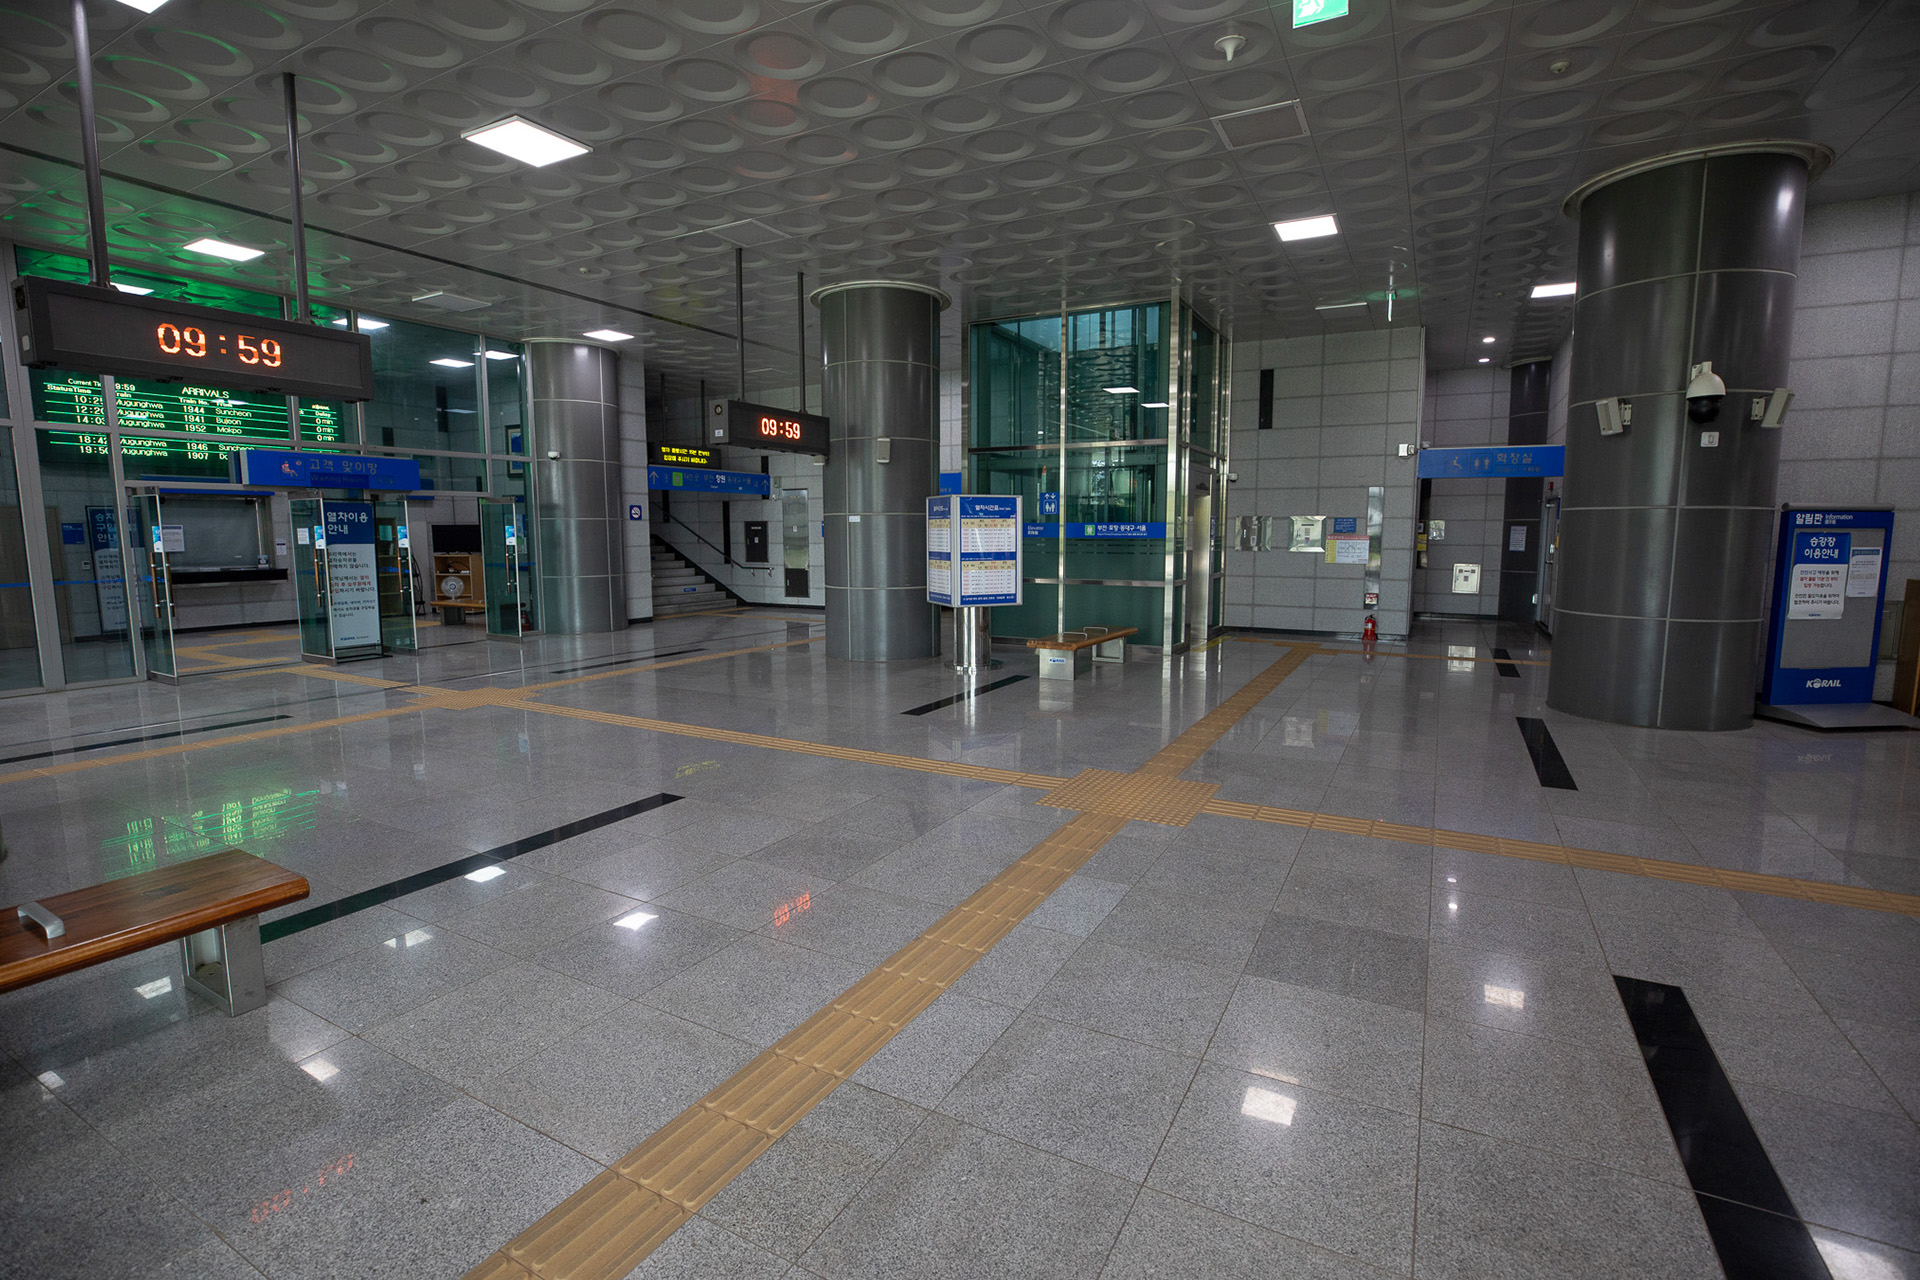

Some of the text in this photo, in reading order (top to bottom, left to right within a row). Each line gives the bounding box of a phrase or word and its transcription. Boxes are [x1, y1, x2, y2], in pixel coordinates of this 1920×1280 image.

[157, 323, 281, 367] 09:59
[68, 378, 91, 387] Current
[115, 382, 135, 391] 9:59
[182, 387, 230, 398] ARRIVALS
[183, 406, 205, 414] 1944
[216, 408, 252, 417] Suncheon
[184, 414, 206, 424] 1941
[185, 424, 206, 432] 1952
[216, 426, 242, 434] Mokpo
[762, 418, 800, 440] 09:59
[186, 442, 208, 450] 1946
[188, 452, 208, 460] 1907
[310, 458, 334, 471] 고객
[326, 512, 368, 523] 열차이용
[1796, 514, 1823, 524] 알림판
[328, 524, 348, 534] 안내
[1810, 536, 1836, 547] 승강장
[1804, 548, 1839, 559] 이용안내
[1806, 678, 1842, 688] KORAIL
